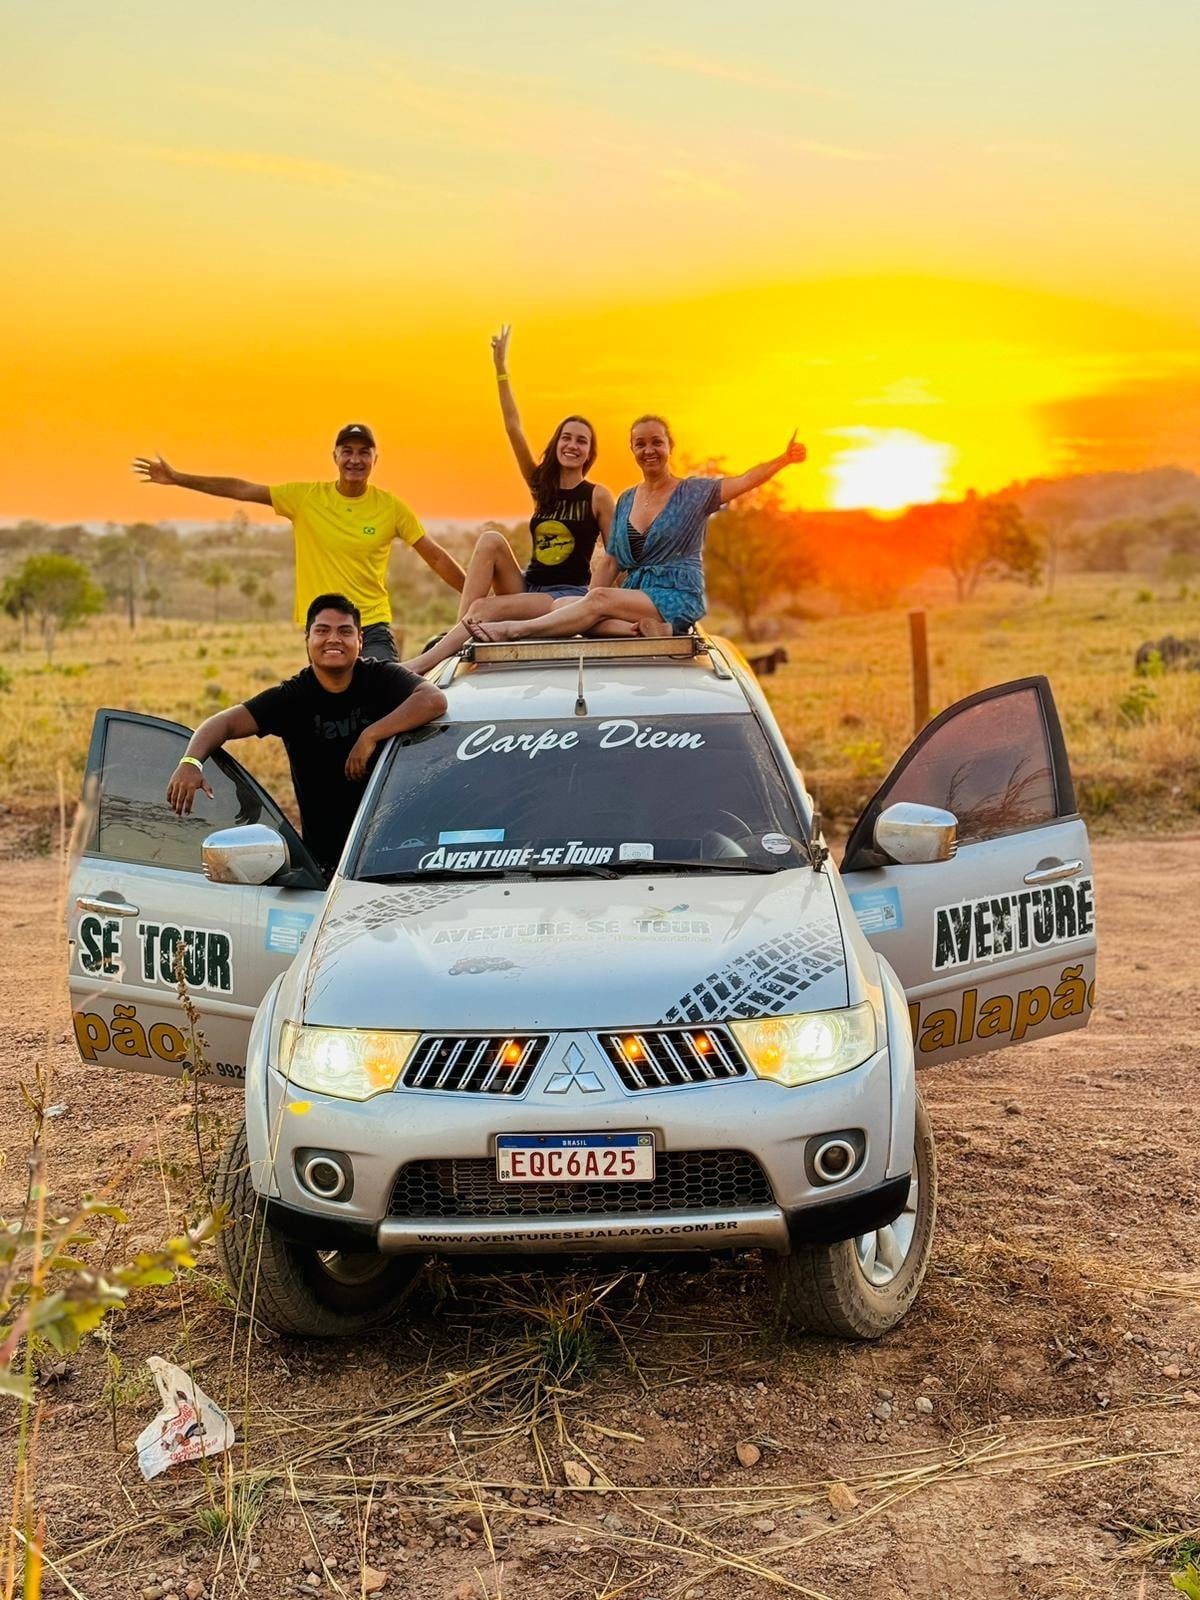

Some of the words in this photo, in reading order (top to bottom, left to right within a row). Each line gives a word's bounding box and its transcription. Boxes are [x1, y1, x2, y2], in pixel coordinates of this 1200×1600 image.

[456, 724, 579, 761] Carpe
[598, 719, 706, 750] Diem
[432, 920, 571, 945] AVENTURE
[587, 920, 620, 934] SE
[636, 920, 712, 934] TOUR
[934, 879, 1094, 969] AVENTURE
[80, 917, 121, 974] SE
[139, 923, 231, 991] TOUR
[907, 964, 1095, 1053] Jalapã
[74, 1004, 187, 1062] pão
[216, 1062, 246, 1080] 992
[511, 1150, 636, 1177] EQC6A25
[418, 1221, 738, 1243] WWW.AVENTURESEJALAPAO.COM.BR
